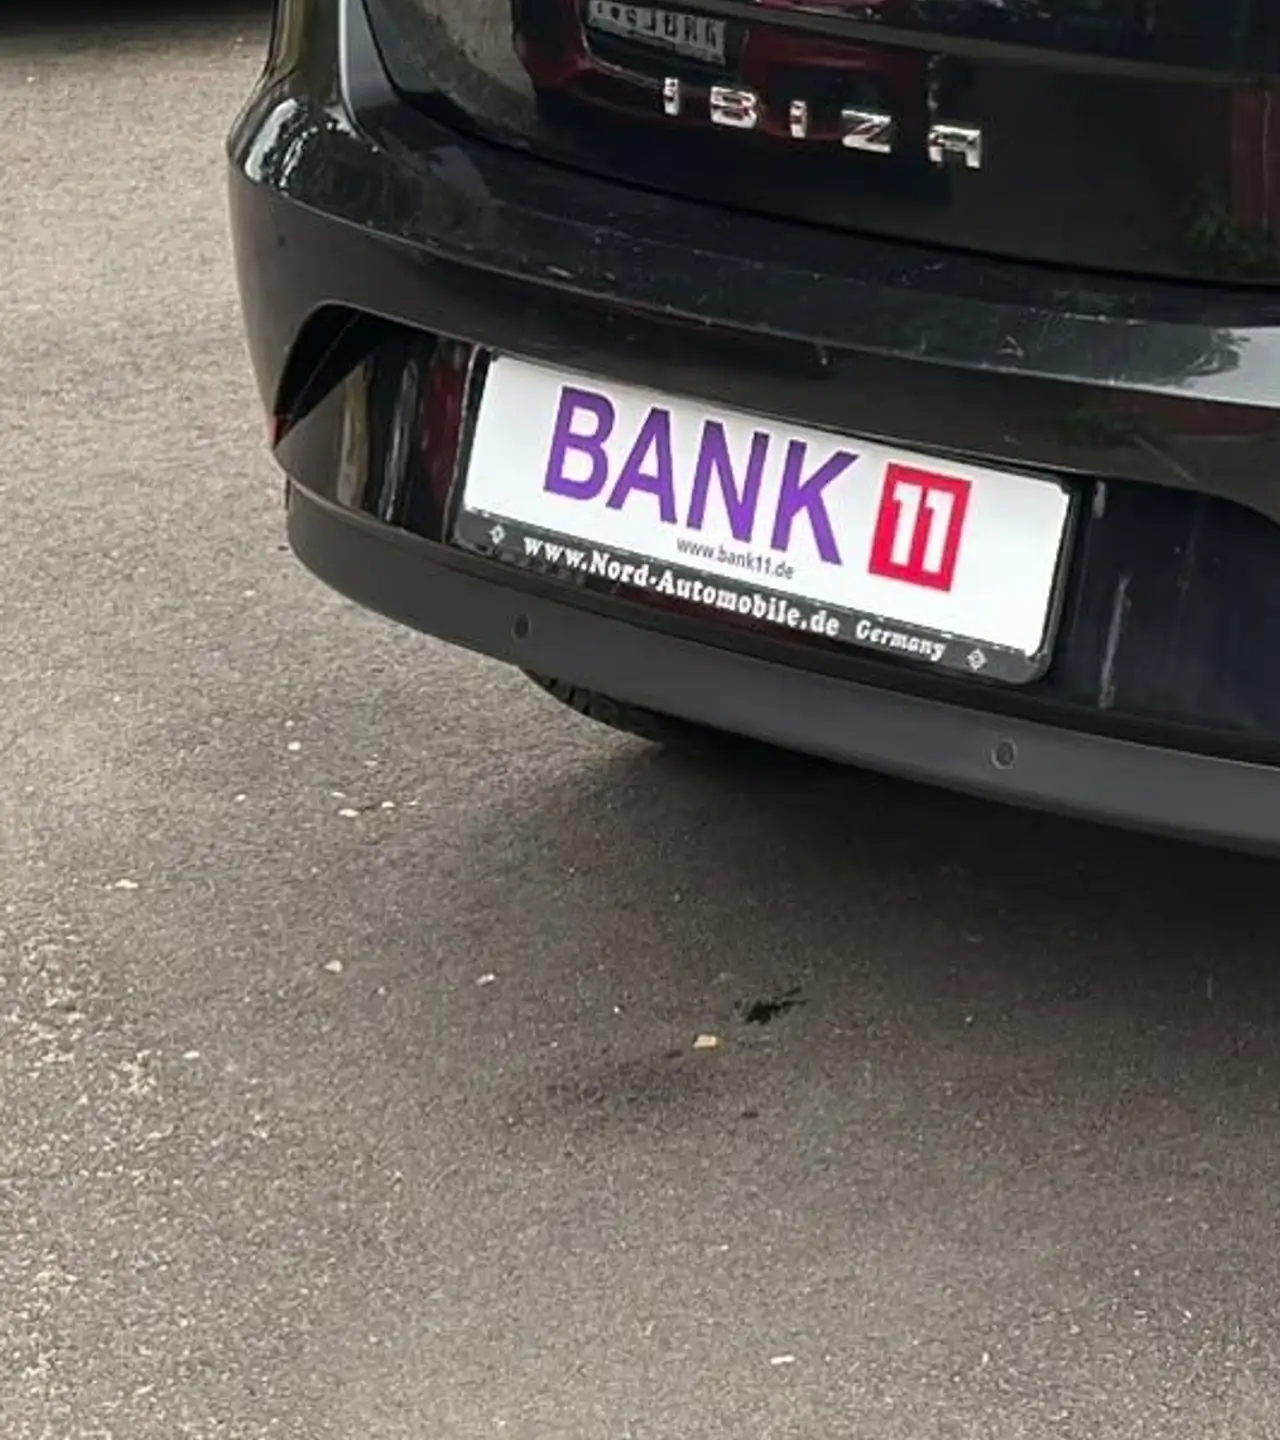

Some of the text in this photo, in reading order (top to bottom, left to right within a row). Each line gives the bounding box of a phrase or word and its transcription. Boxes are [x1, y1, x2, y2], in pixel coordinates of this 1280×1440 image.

[661, 76, 983, 169] IBIZA
[543, 385, 955, 575] BANK 11
[523, 535, 947, 661] www.Nord-Automobile.de Germany
[676, 536, 796, 580] www.bank11.de
